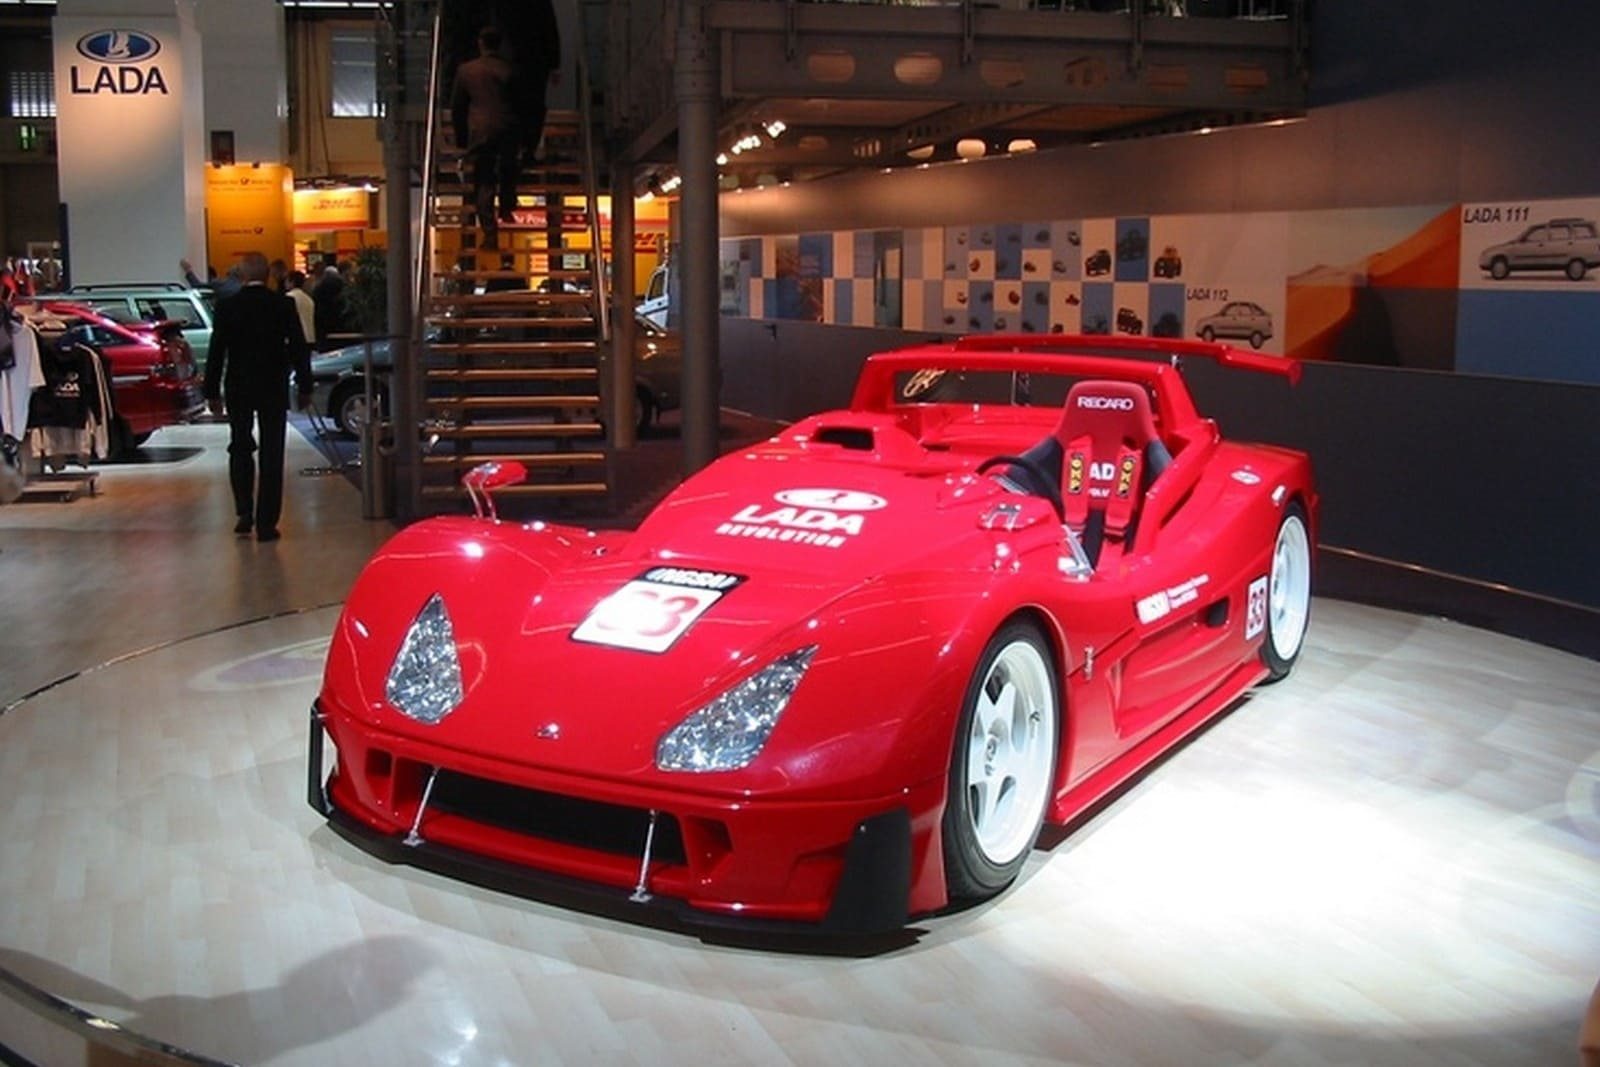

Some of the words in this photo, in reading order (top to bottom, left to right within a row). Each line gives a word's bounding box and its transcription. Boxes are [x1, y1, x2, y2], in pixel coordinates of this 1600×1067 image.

[71, 66, 168, 94] LADA
[1464, 207, 1501, 224] LADA
[1506, 206, 1530, 221] 111
[1187, 287, 1211, 301] LADA
[1077, 396, 1134, 411] RECARO
[1089, 462, 1116, 481] AD
[730, 504, 865, 536] LADA
[714, 522, 847, 548] REVOLUTION
